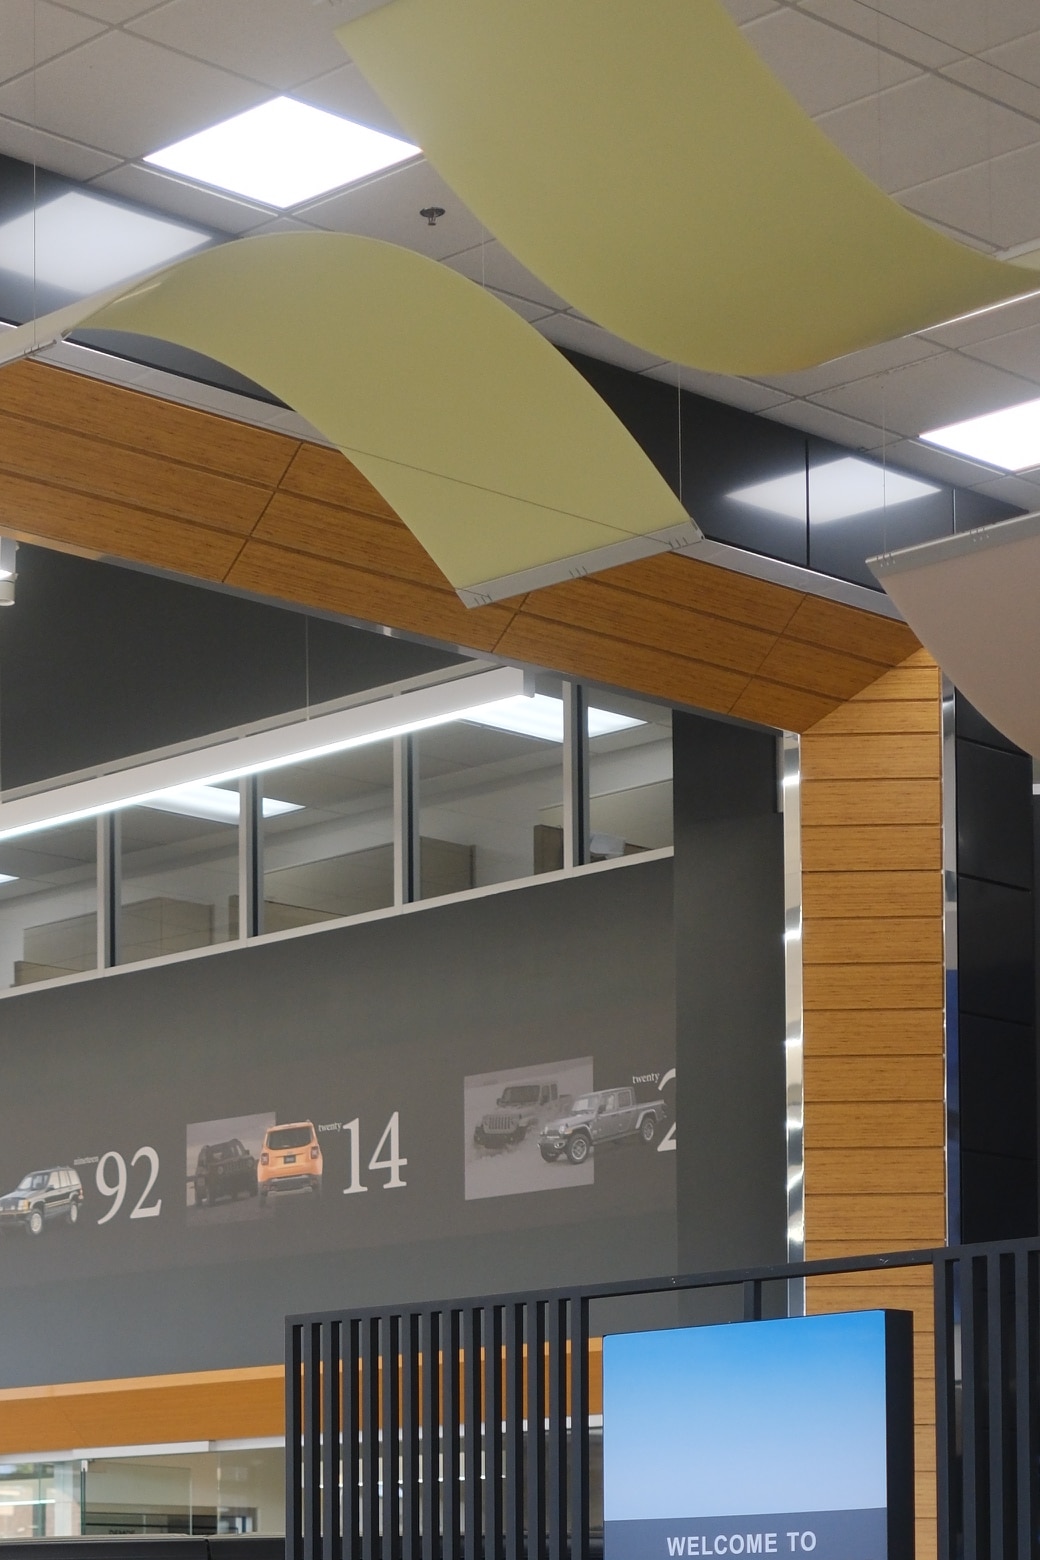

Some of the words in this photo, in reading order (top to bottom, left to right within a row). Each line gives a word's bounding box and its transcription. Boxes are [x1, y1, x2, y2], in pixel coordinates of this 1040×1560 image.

[632, 1072, 660, 1084] twenty
[318, 1121, 343, 1133] twenty
[343, 1111, 408, 1194] 14
[96, 1146, 162, 1225] 92
[666, 1532, 778, 1557] WELCOME
[786, 1530, 817, 1553] TO
